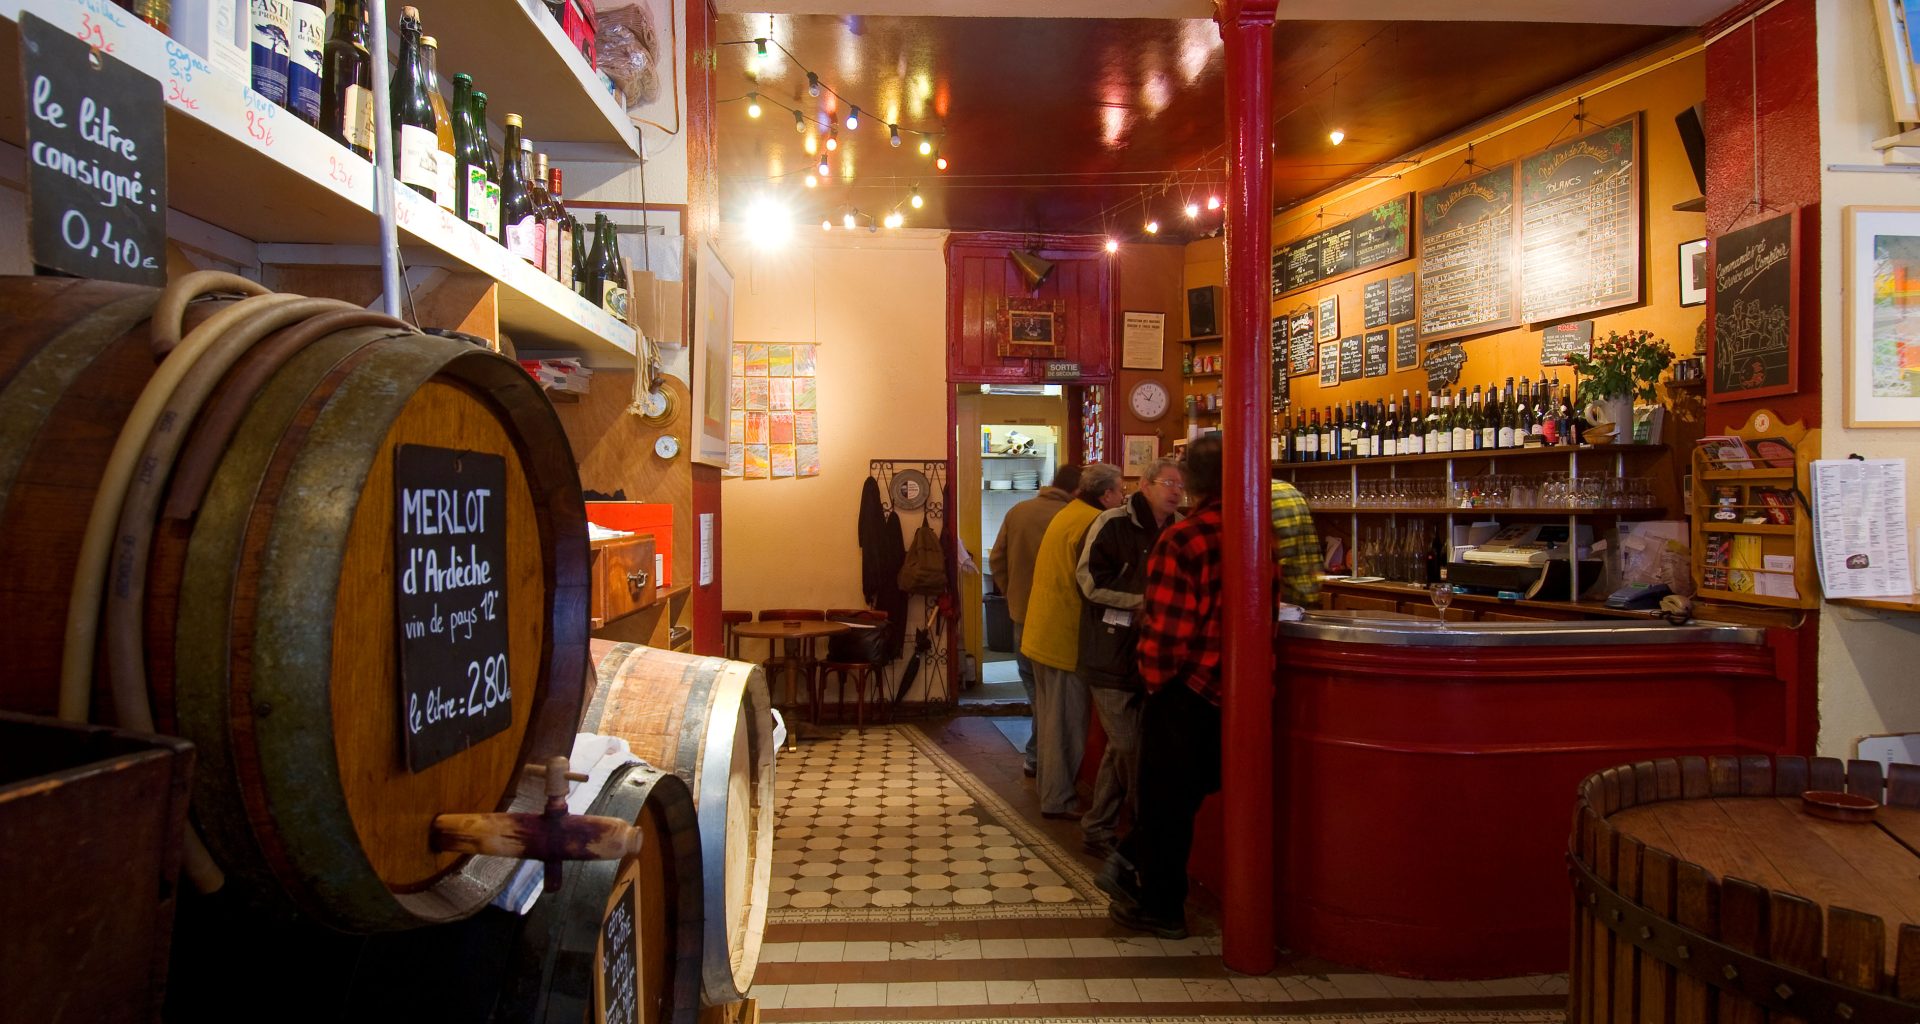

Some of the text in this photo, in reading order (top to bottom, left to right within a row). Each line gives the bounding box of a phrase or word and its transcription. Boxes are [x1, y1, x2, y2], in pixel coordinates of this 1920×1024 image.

[165, 41, 212, 75] Cognac
[168, 59, 193, 83] Bio
[168, 79, 200, 110] 34€
[33, 75, 138, 161] le litre
[246, 110, 275, 147] 25€
[61, 209, 159, 269] 0,40€
[1717, 270, 1744, 293] Service
[1050, 363, 1078, 371] SORTIE
[403, 488, 491, 535] MERLOT
[402, 544, 492, 596] d'Ardèche
[405, 615, 425, 639] vin
[430, 602, 445, 634] de
[450, 606, 478, 644] pays
[409, 692, 423, 735] le
